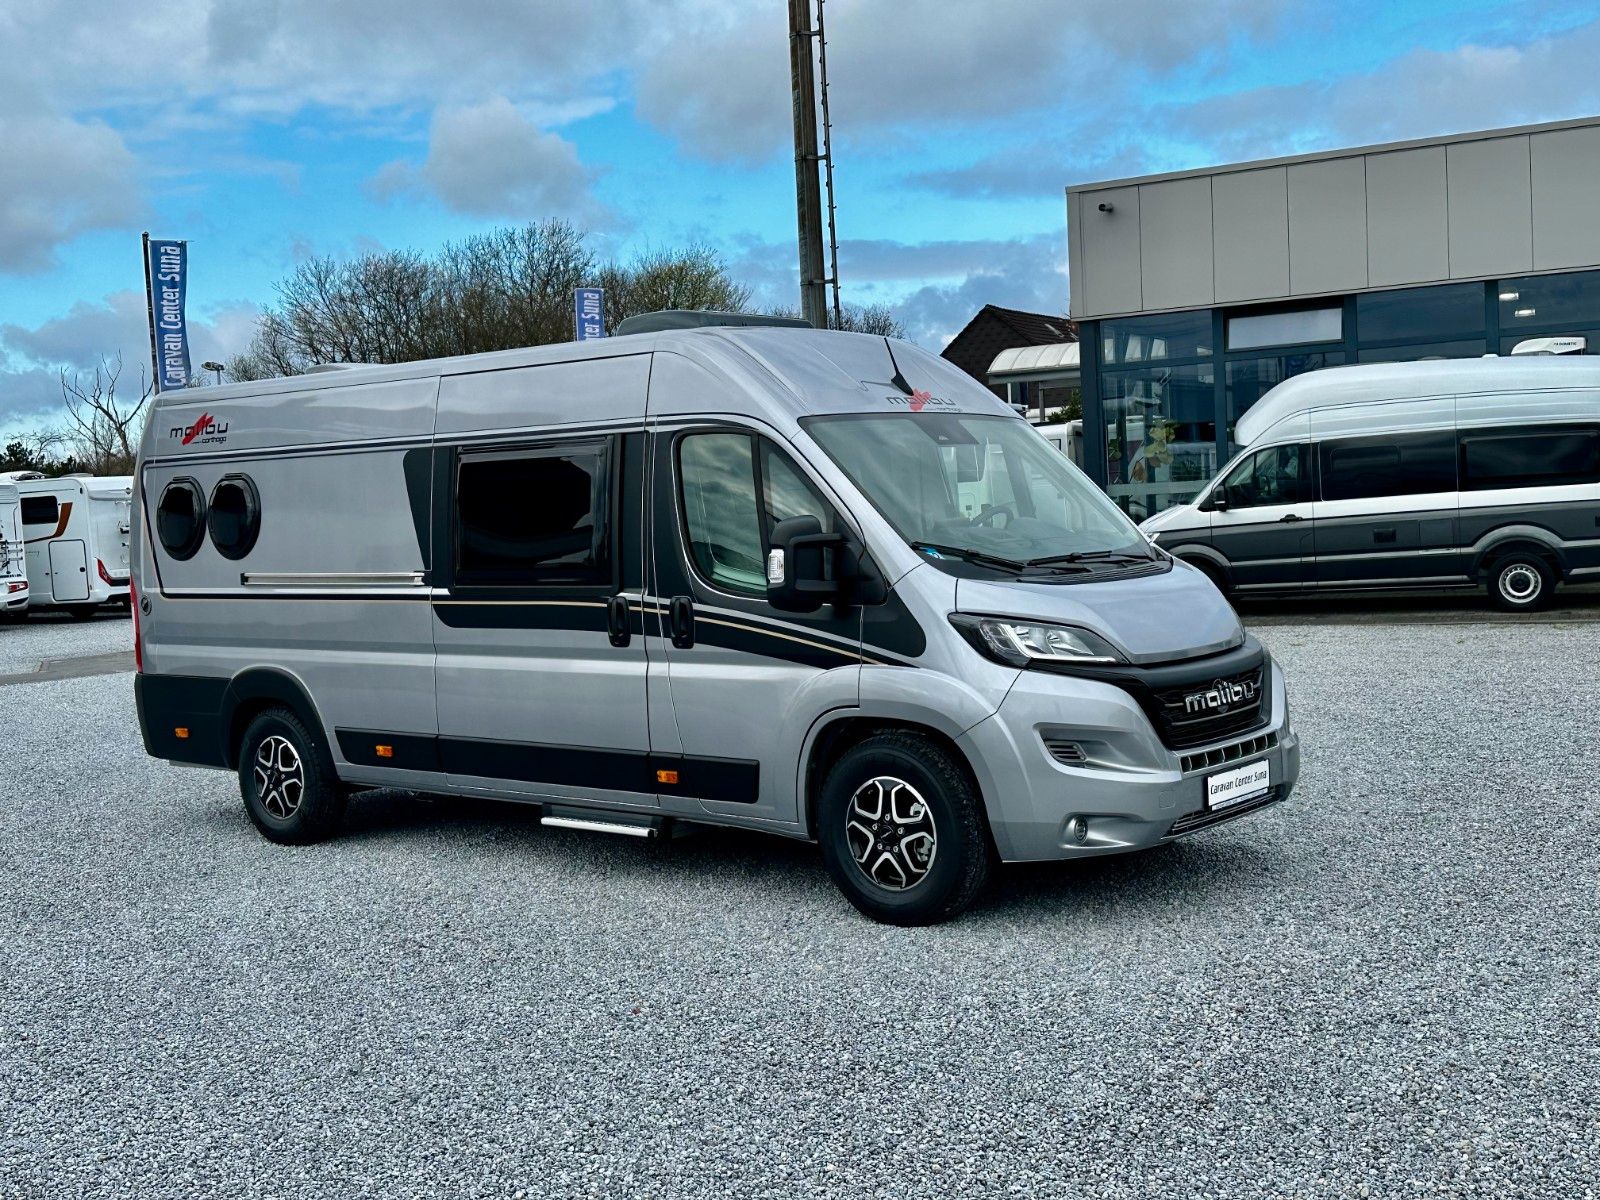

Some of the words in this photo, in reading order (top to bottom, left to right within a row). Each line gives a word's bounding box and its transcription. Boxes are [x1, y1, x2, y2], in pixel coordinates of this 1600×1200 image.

[158, 246, 181, 282] Suna
[160, 287, 181, 329] Center
[581, 292, 600, 320] Suna
[164, 333, 187, 387] Caravan
[169, 422, 229, 439] malibu
[1185, 680, 1256, 713] malibu
[1210, 780, 1234, 795] Caravan
[1234, 774, 1254, 788] Center
[1254, 770, 1267, 782] Suna
